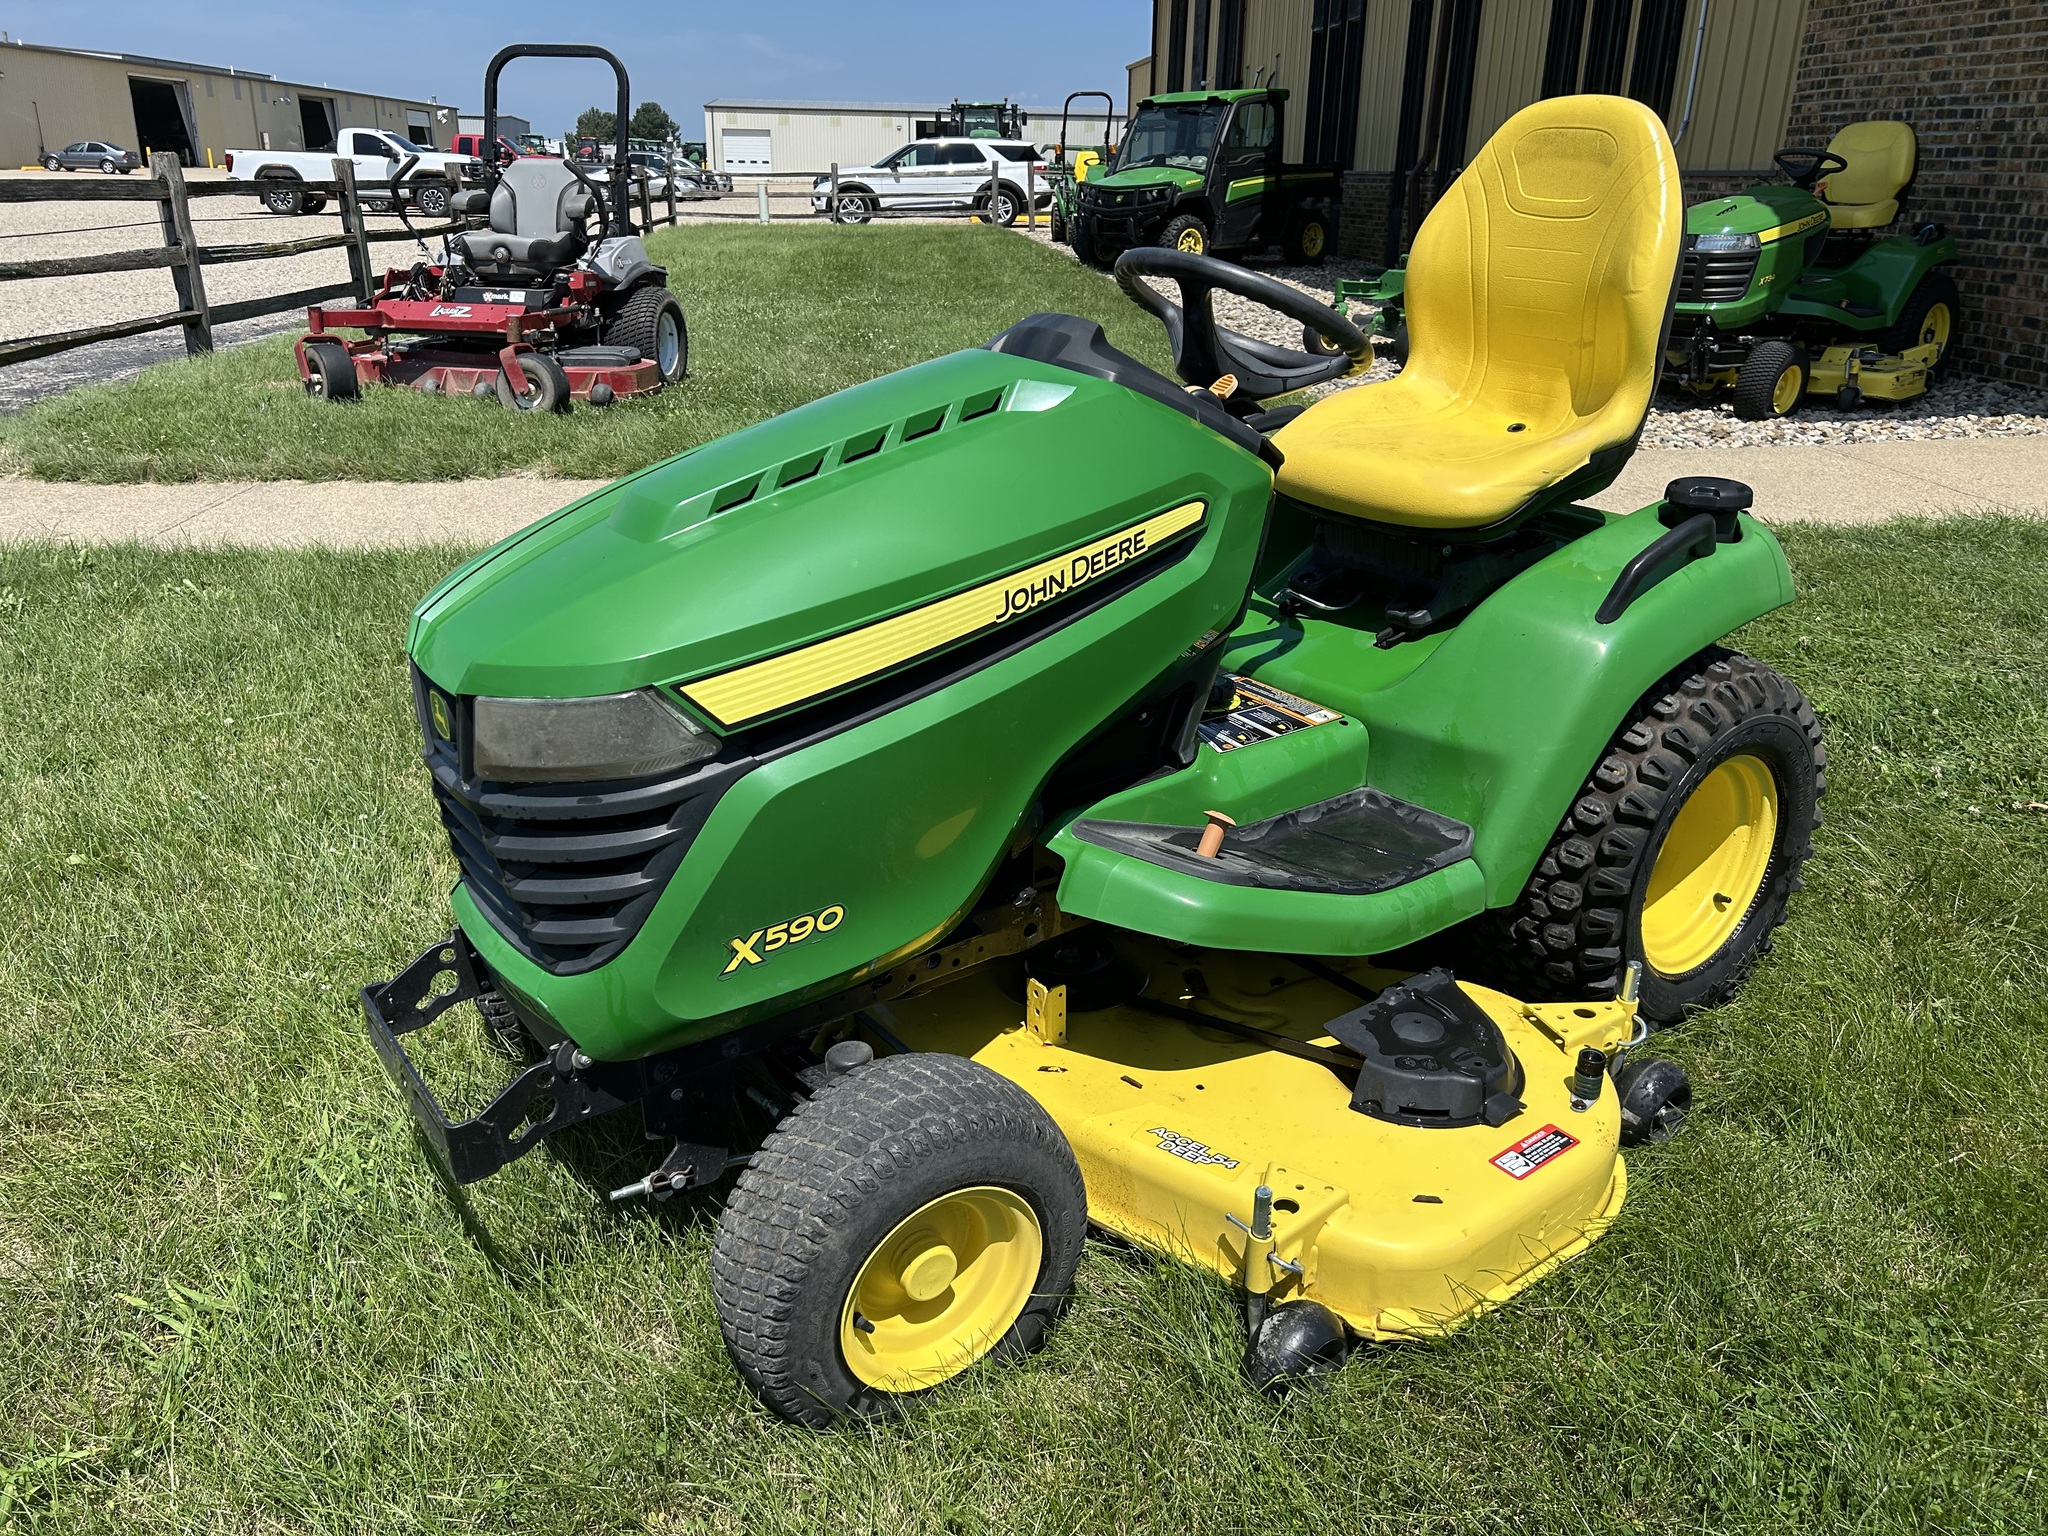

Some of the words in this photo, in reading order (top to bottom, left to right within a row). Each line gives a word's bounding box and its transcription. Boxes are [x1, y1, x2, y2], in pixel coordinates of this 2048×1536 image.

[1797, 221, 1811, 233] JOHN
[1810, 213, 1824, 226] DEERE
[995, 568, 1066, 621] JOHN
[1071, 529, 1148, 587] DEERE
[719, 903, 846, 976] X590
[1146, 1126, 1211, 1158] ACCEL
[1209, 1152, 1240, 1169] 54
[1156, 1139, 1213, 1165] DEEP
[1524, 1130, 1547, 1145] DANGER
